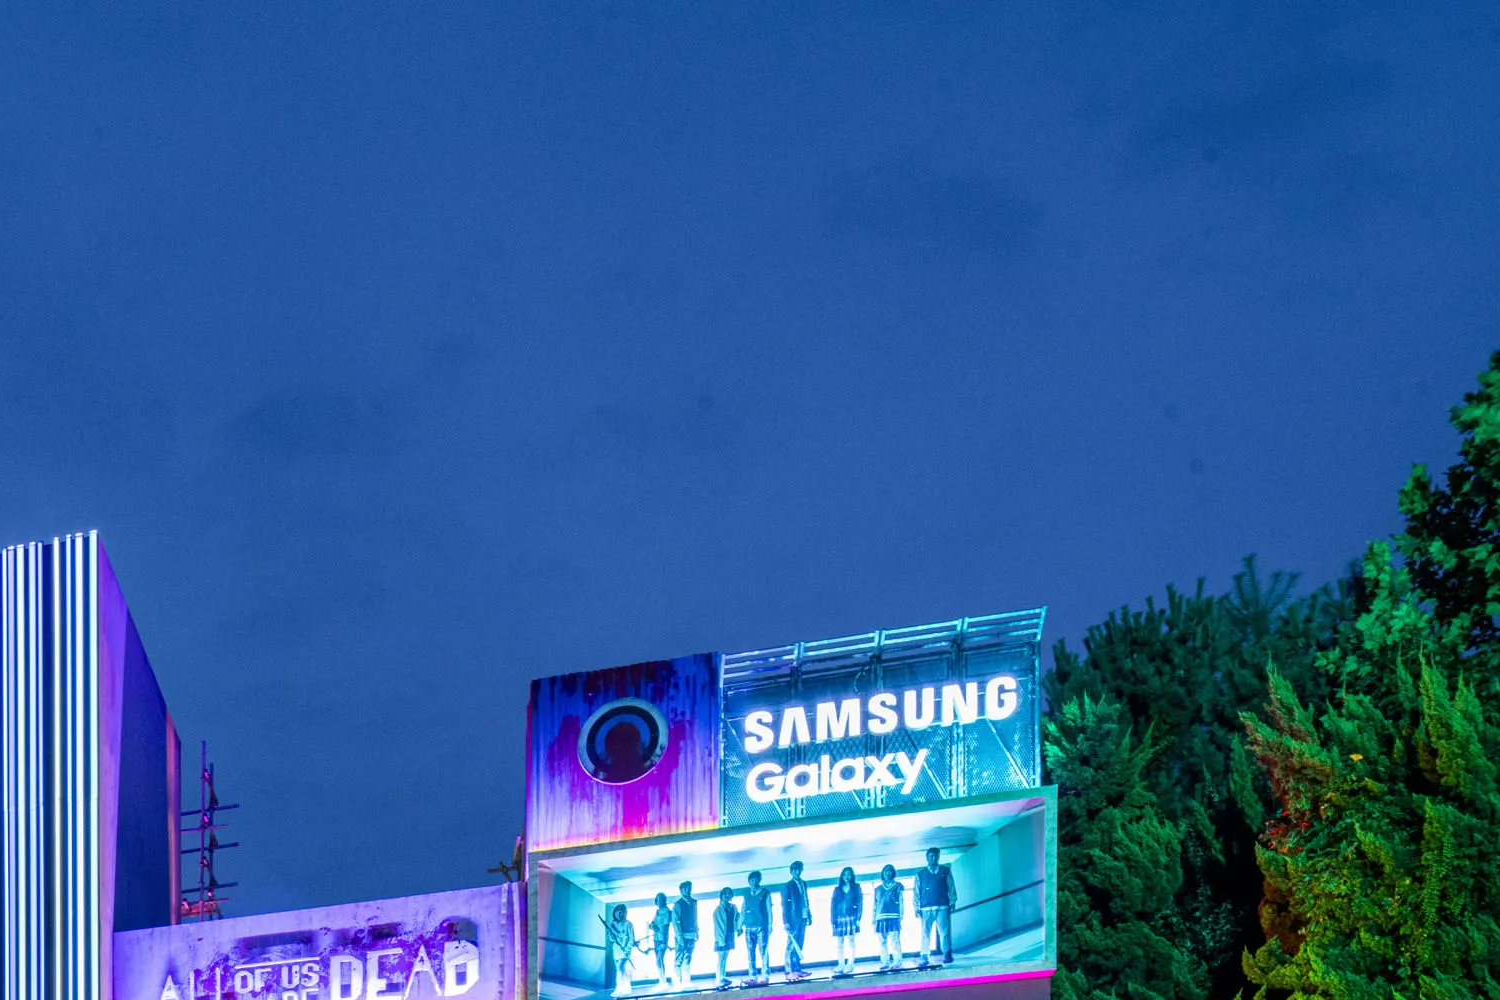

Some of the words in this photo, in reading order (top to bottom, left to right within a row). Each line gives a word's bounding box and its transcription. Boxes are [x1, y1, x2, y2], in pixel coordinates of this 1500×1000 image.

[744, 676, 1018, 753] SAMSUNG
[745, 748, 929, 803] Galaxy
[234, 967, 268, 994] OF
[281, 962, 321, 988] US
